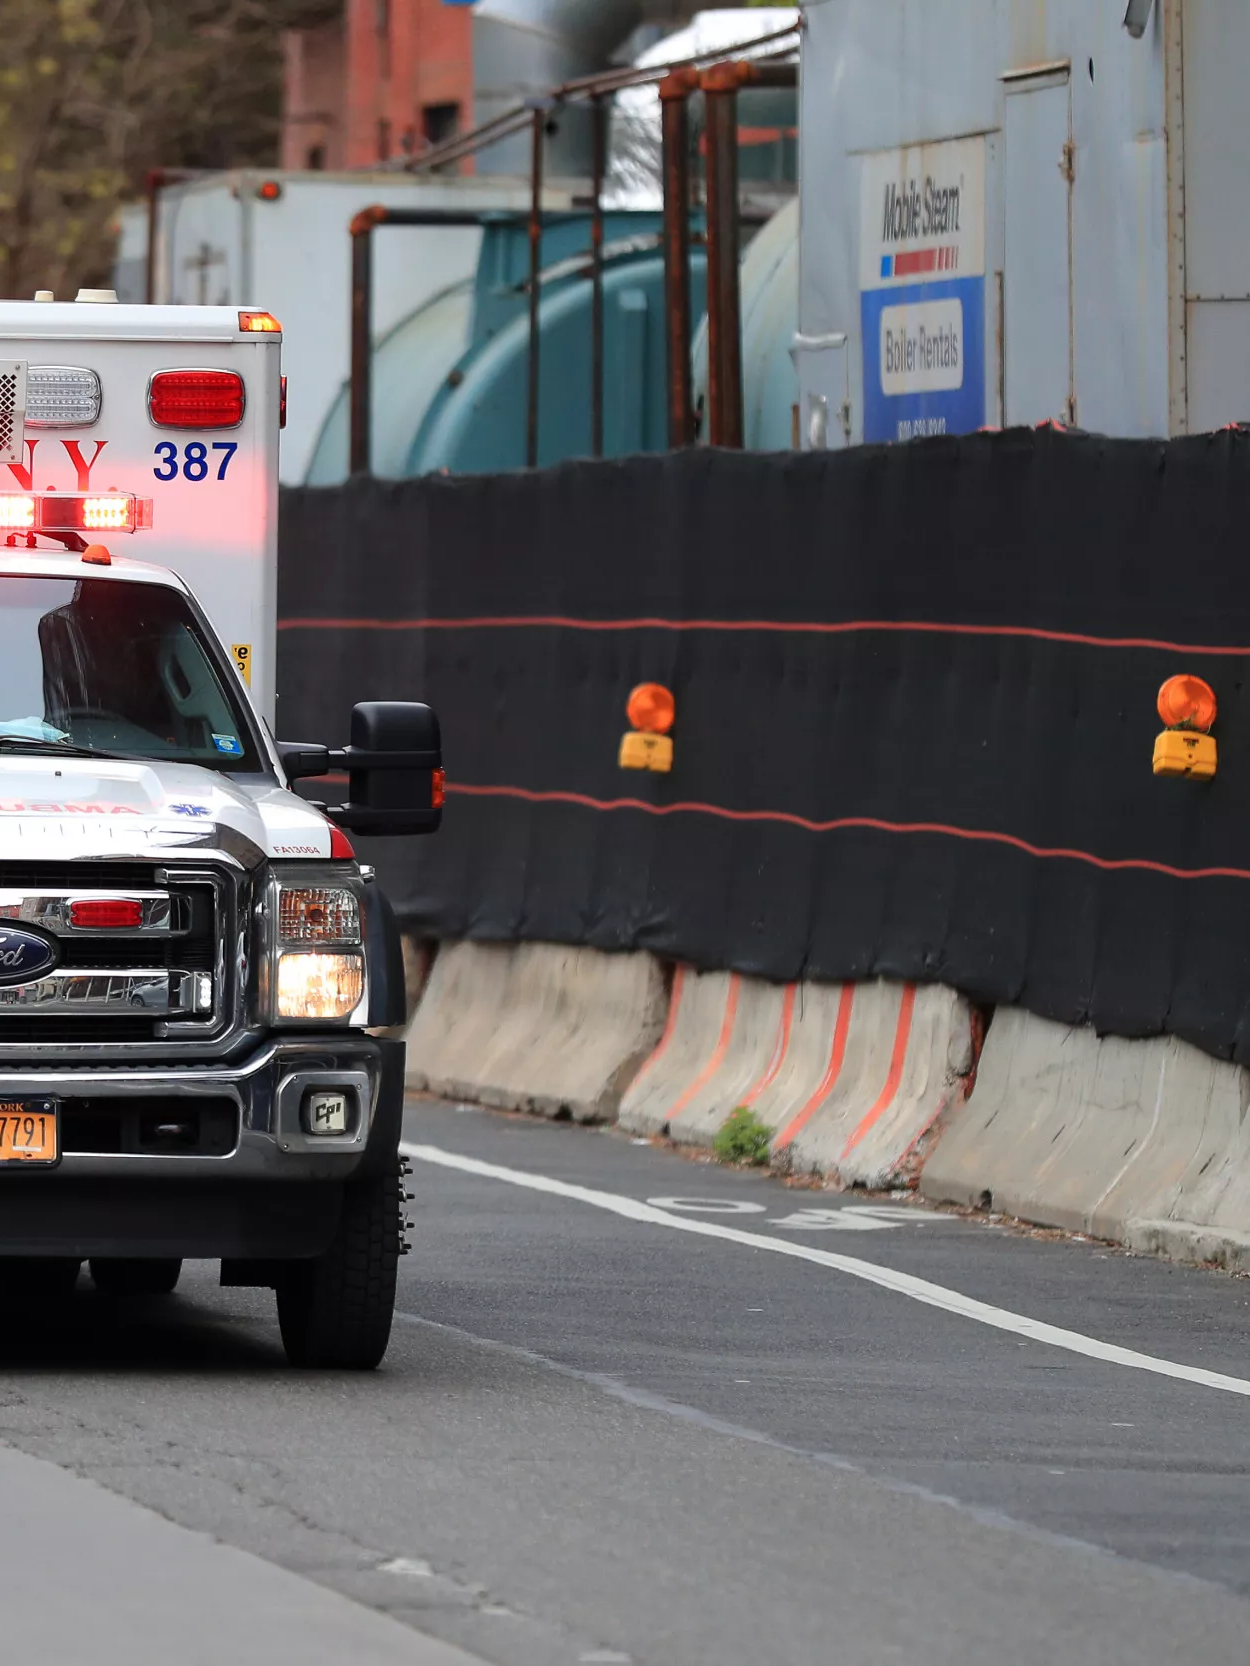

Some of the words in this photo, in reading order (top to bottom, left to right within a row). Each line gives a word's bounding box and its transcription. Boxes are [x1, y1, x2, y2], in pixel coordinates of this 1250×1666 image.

[882, 179, 922, 242] Mobile
[922, 174, 960, 237] Steam
[886, 327, 917, 374] Boiler
[919, 322, 958, 370] Rentals
[153, 441, 238, 481] 387
[273, 846, 320, 854] FA13064
